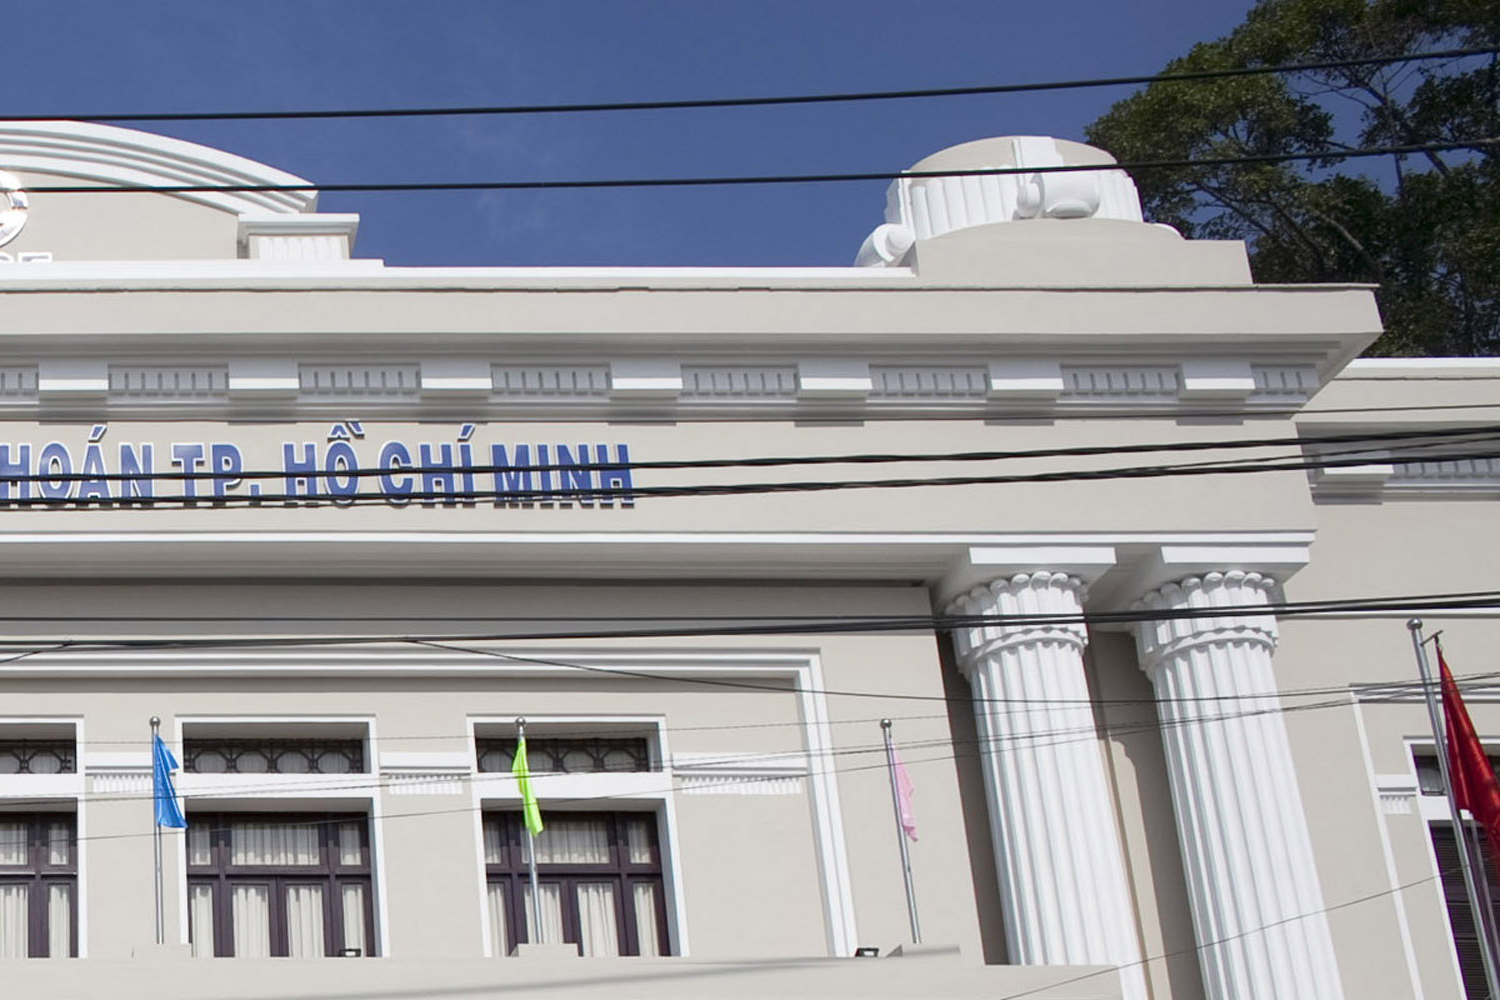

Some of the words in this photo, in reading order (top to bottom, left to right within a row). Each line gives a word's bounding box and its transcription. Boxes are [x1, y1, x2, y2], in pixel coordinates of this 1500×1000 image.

[171, 441, 262, 505] TP.
[282, 420, 364, 506] HỒ
[379, 423, 477, 506] CHÍ
[490, 441, 636, 506] MINH
